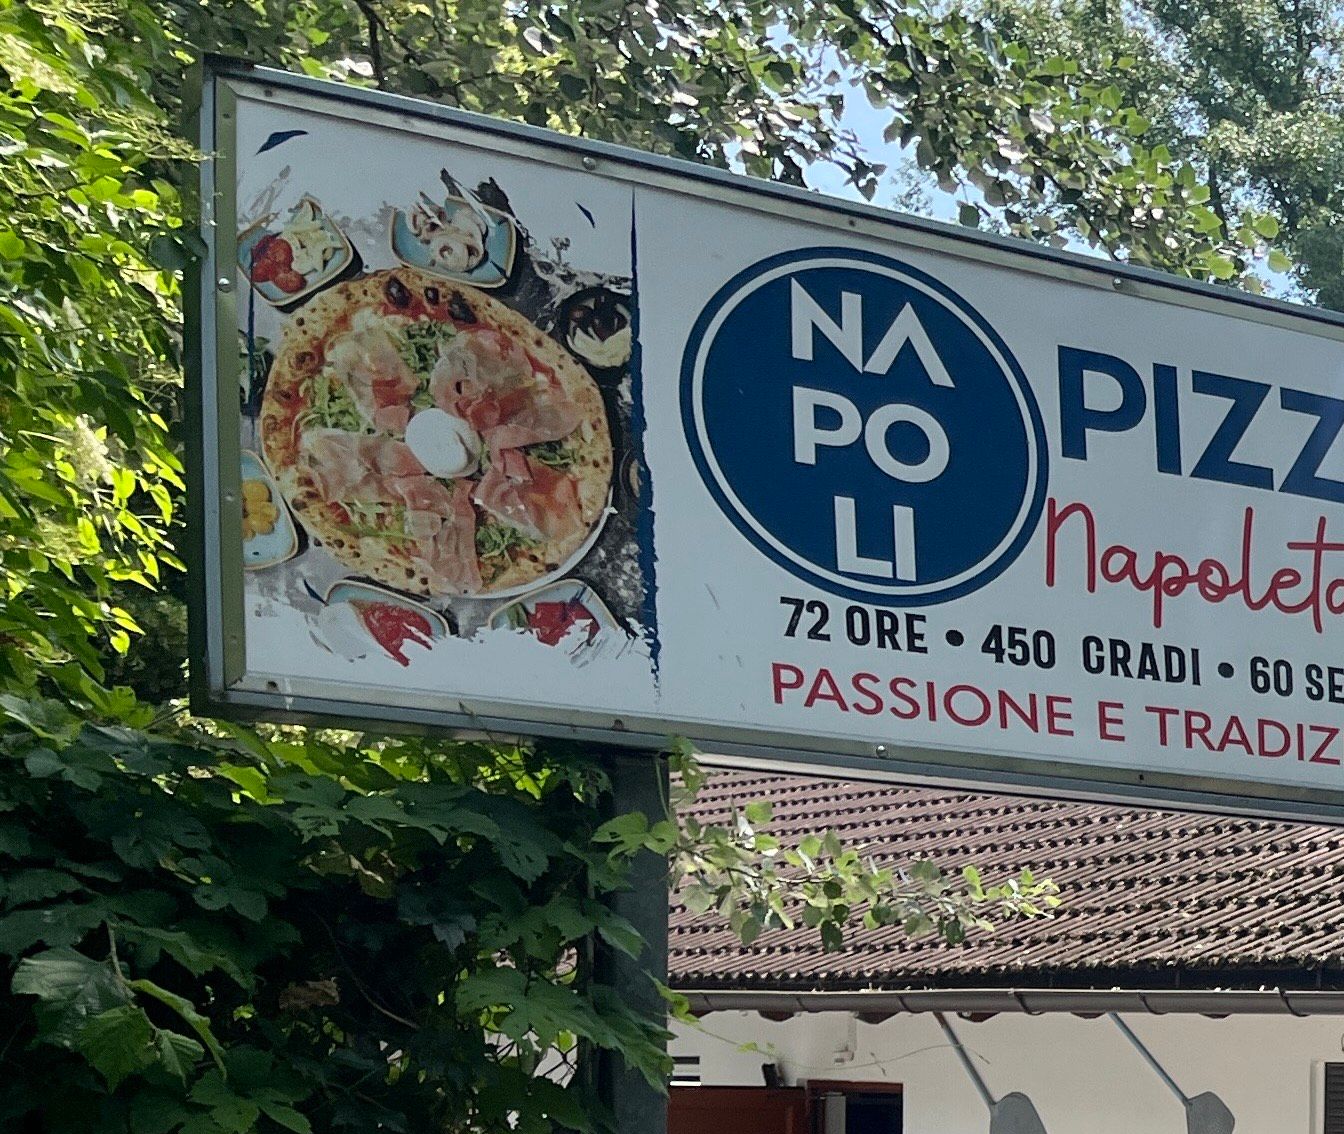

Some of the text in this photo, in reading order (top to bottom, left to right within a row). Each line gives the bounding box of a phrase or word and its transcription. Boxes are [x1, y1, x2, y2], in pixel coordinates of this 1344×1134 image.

[791, 277, 955, 388] NA
[793, 386, 950, 483] PO
[834, 496, 917, 582] LI
[780, 597, 831, 641] 72
[846, 605, 928, 654] ORE
[981, 625, 1056, 669] 450
[1082, 635, 1201, 686] GRADI
[1250, 656, 1293, 696] 60
[772, 662, 1074, 737] PASSIONE
[1098, 701, 1126, 742] E
